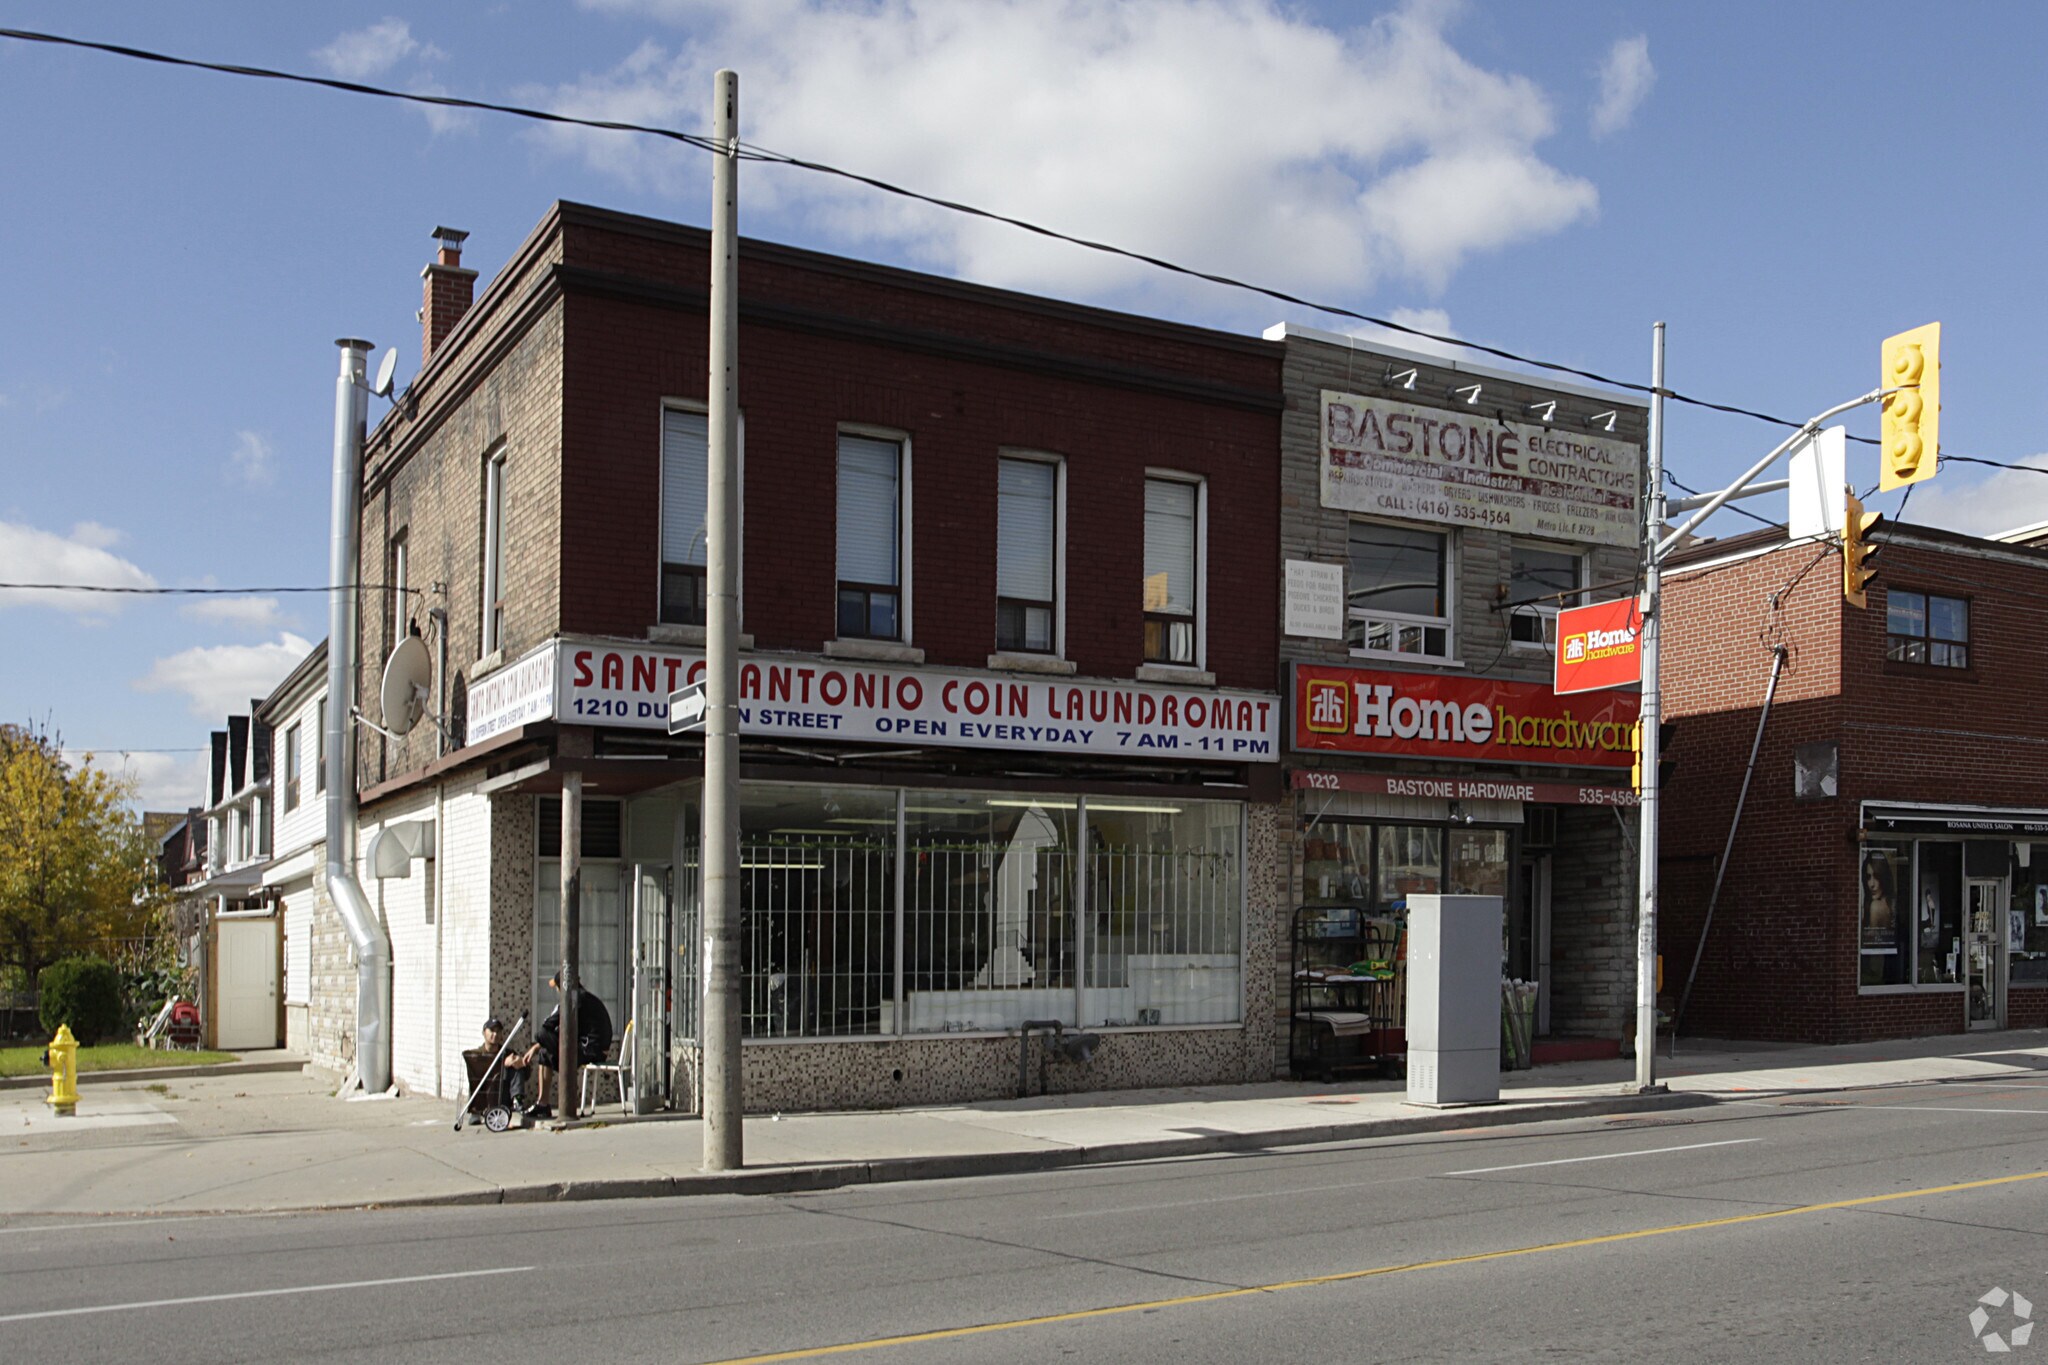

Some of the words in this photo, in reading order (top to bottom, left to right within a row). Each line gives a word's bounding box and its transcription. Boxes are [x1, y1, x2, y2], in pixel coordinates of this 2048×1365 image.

[1328, 402, 1520, 471] BASTONE
[1528, 436, 1613, 465] ELECTRICAL
[1363, 456, 1443, 478] Commercial
[1463, 469, 1523, 490] Industrial
[1528, 458, 1635, 489] CONTRACTORS
[1416, 498, 1449, 518] (416)
[1454, 505, 1511, 525] 535-4564
[1444, 486, 1471, 500] DRYERS
[1478, 492, 1525, 509] DISHWASHERS
[1533, 499, 1560, 514] FRIDGES
[1567, 504, 1598, 519] FREEZERS
[1587, 627, 1636, 650] Home
[1587, 643, 1635, 660] hardware
[573, 698, 629, 717] 1210
[740, 663, 923, 711] ANTONIO
[941, 679, 1029, 718] COIN
[1048, 686, 1271, 733] LAUNDROMAT
[759, 708, 843, 731] STREET
[875, 717, 947, 736] OPEN
[959, 722, 1094, 744] EVERYDAY
[1354, 682, 1493, 744] Home
[1495, 705, 1633, 751] hardwar
[1307, 773, 1340, 790] 1212
[1386, 778, 1454, 798] BASTONE
[1458, 782, 1535, 801] HARDWARE
[1579, 788, 1640, 806] 535-4564
[1994, 822, 2014, 830] SALON
